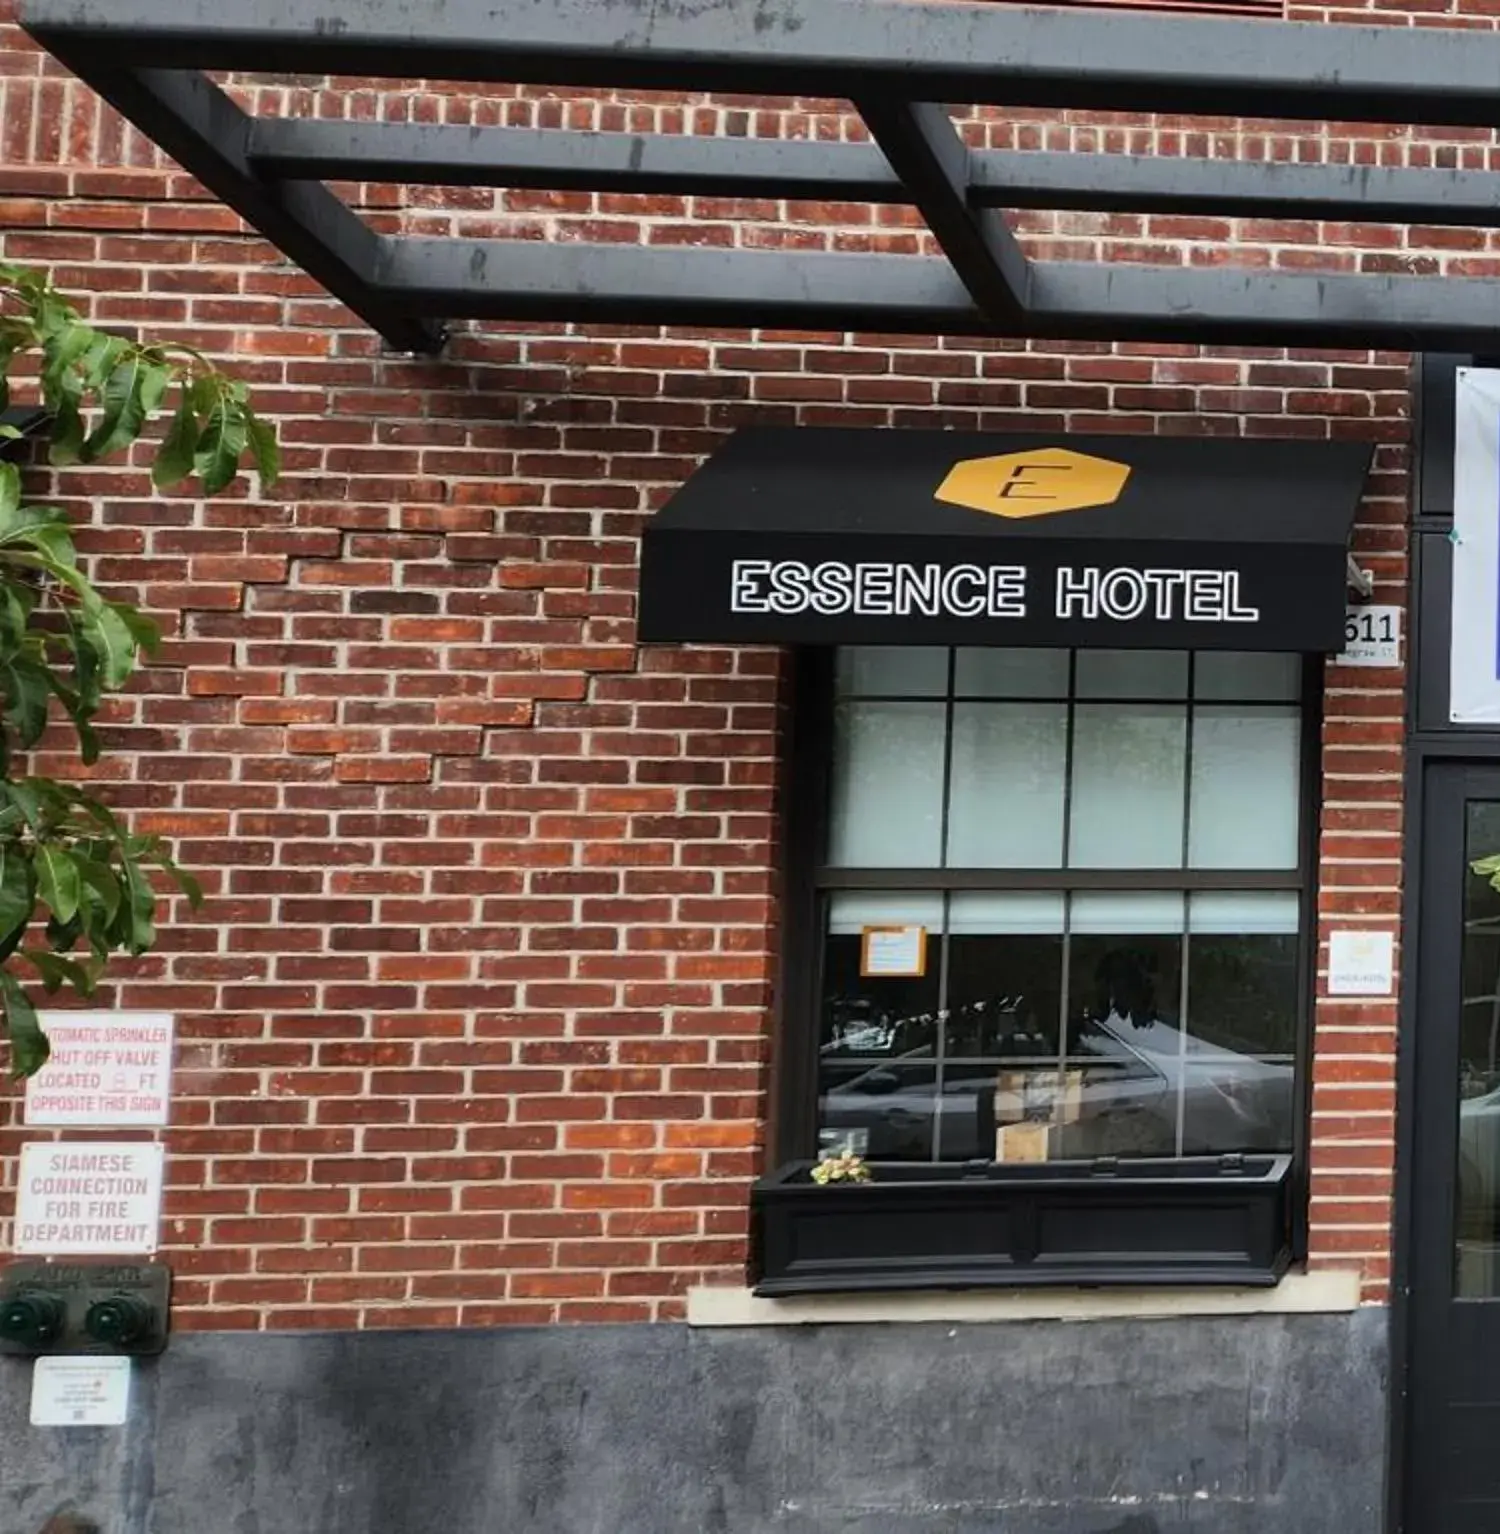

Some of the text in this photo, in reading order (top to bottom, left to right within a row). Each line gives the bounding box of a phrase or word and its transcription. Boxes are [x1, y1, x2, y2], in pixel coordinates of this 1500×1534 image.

[731, 559, 1260, 622] ESSENCE HOTEL
[1344, 613, 1395, 642] 611
[51, 1050, 160, 1066] HUT OFF VALVE
[37, 1072, 101, 1089] LOCATED
[31, 1095, 162, 1112] OPPOSITE THIS SIGN
[50, 1154, 133, 1173] SIAMESE
[30, 1177, 148, 1195] CONNECTION
[45, 1201, 129, 1219] FOR FIRE
[22, 1224, 148, 1242] DEPARTMENT
